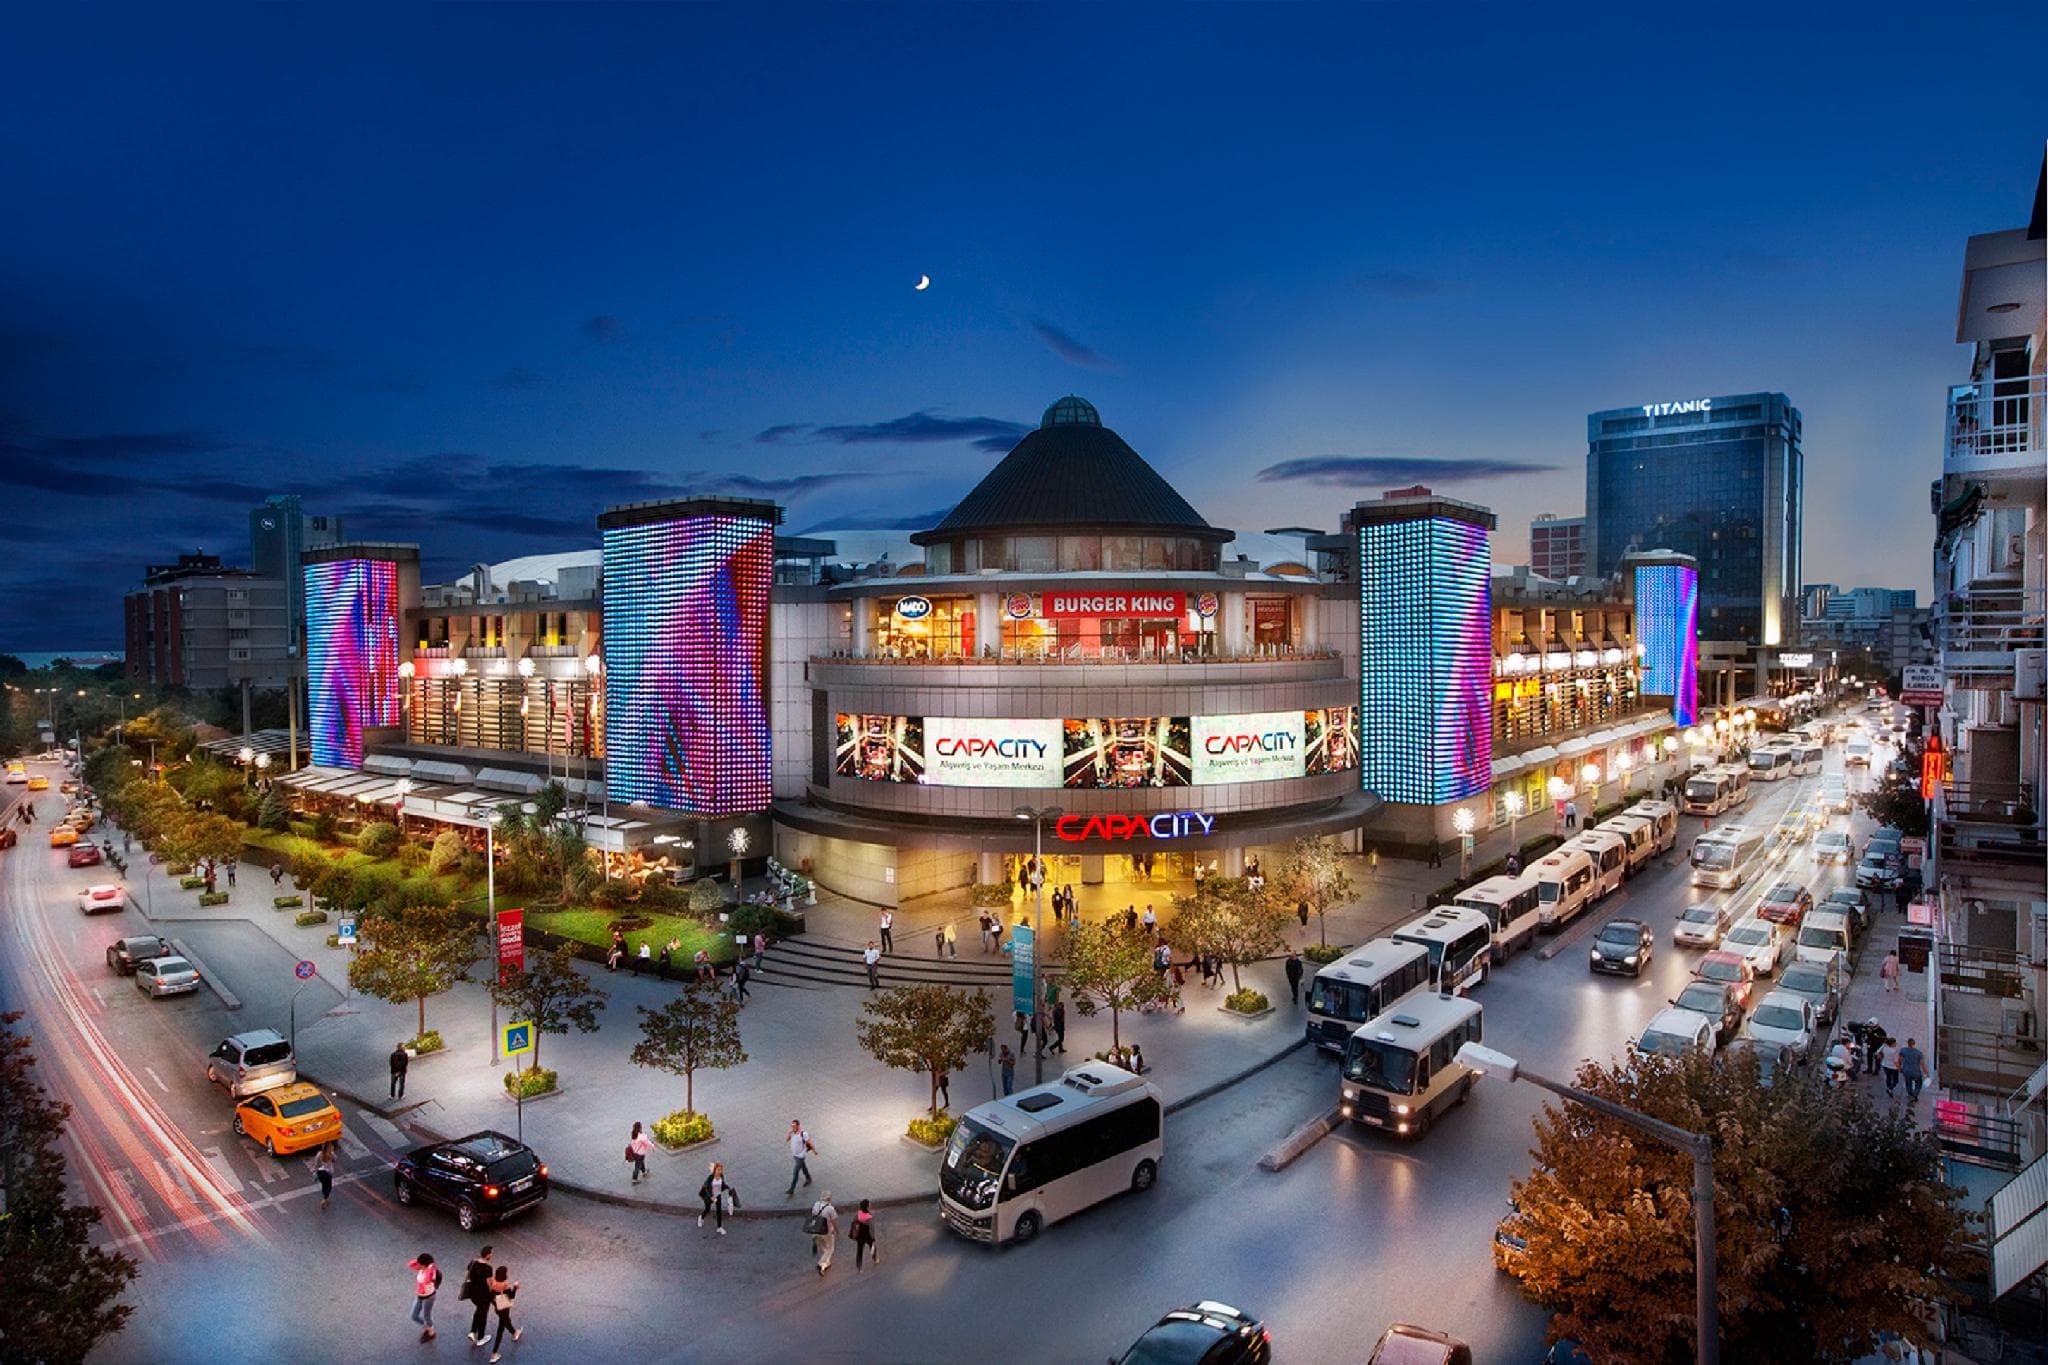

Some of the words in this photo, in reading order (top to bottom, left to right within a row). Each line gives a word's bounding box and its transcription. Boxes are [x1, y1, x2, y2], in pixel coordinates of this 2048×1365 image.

[1643, 399, 1711, 416] TITANIC
[900, 601, 926, 612] MADO
[1054, 596, 1127, 612] BURGER
[1131, 596, 1175, 612] KING
[936, 738, 1047, 758] CAPACITY
[1205, 731, 1297, 754] CAPACITY
[1056, 812, 1214, 840] CAPACITY
